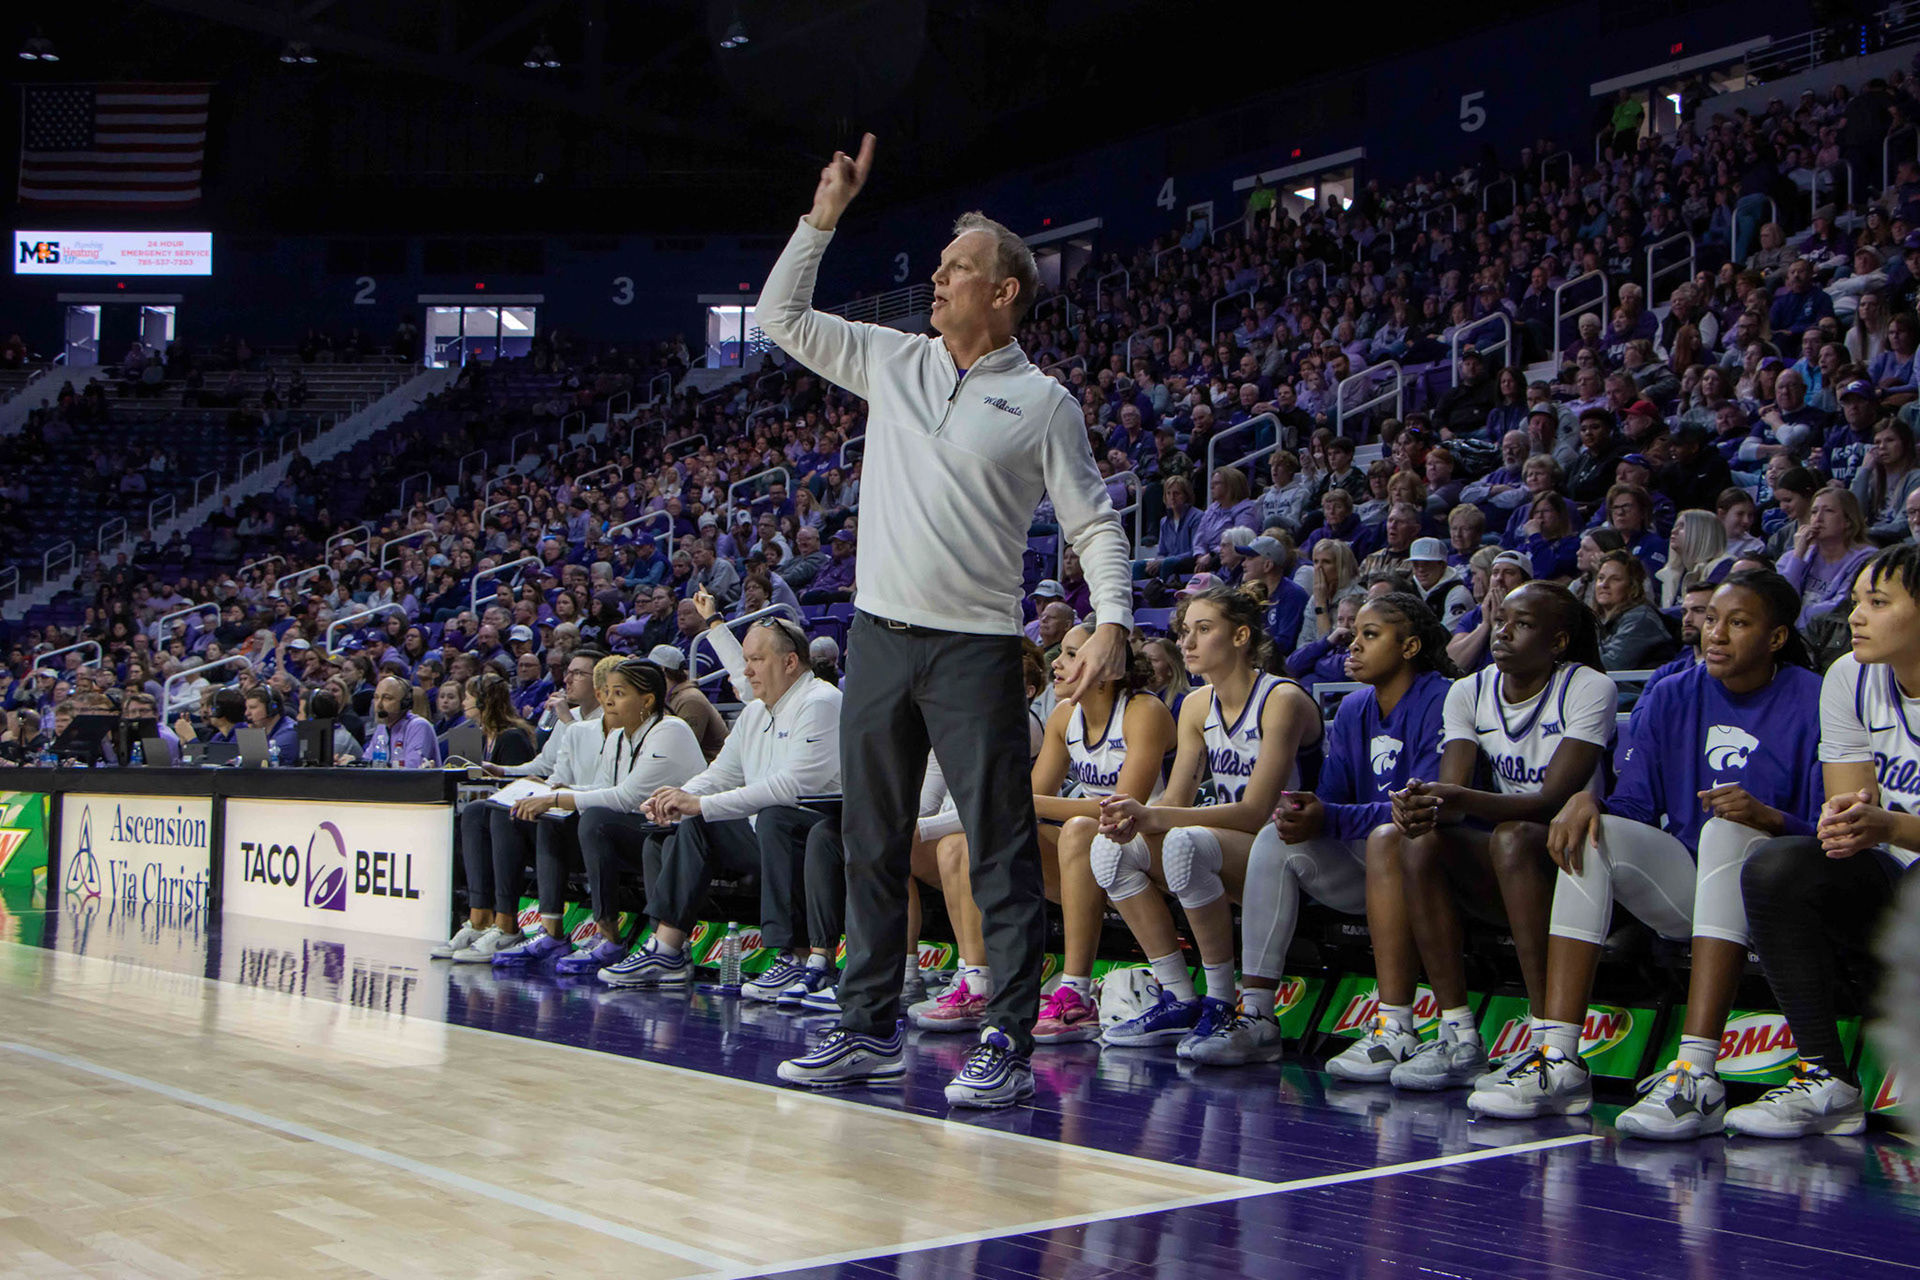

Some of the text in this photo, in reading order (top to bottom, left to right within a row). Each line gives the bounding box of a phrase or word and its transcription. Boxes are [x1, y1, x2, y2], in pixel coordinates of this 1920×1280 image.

[1460, 90, 1487, 132] 5
[1156, 177, 1177, 211] 4
[20, 242, 60, 264] M&S
[62, 247, 100, 259] Heating
[894, 252, 910, 282] 3
[354, 277, 377, 305] 2
[612, 277, 635, 305] 3
[984, 396, 1022, 417] Wildcats
[1070, 757, 1124, 787] Wildca
[110, 803, 207, 848] Ascension
[109, 859, 209, 910] Via Christi
[241, 842, 419, 899] TACO BELL
